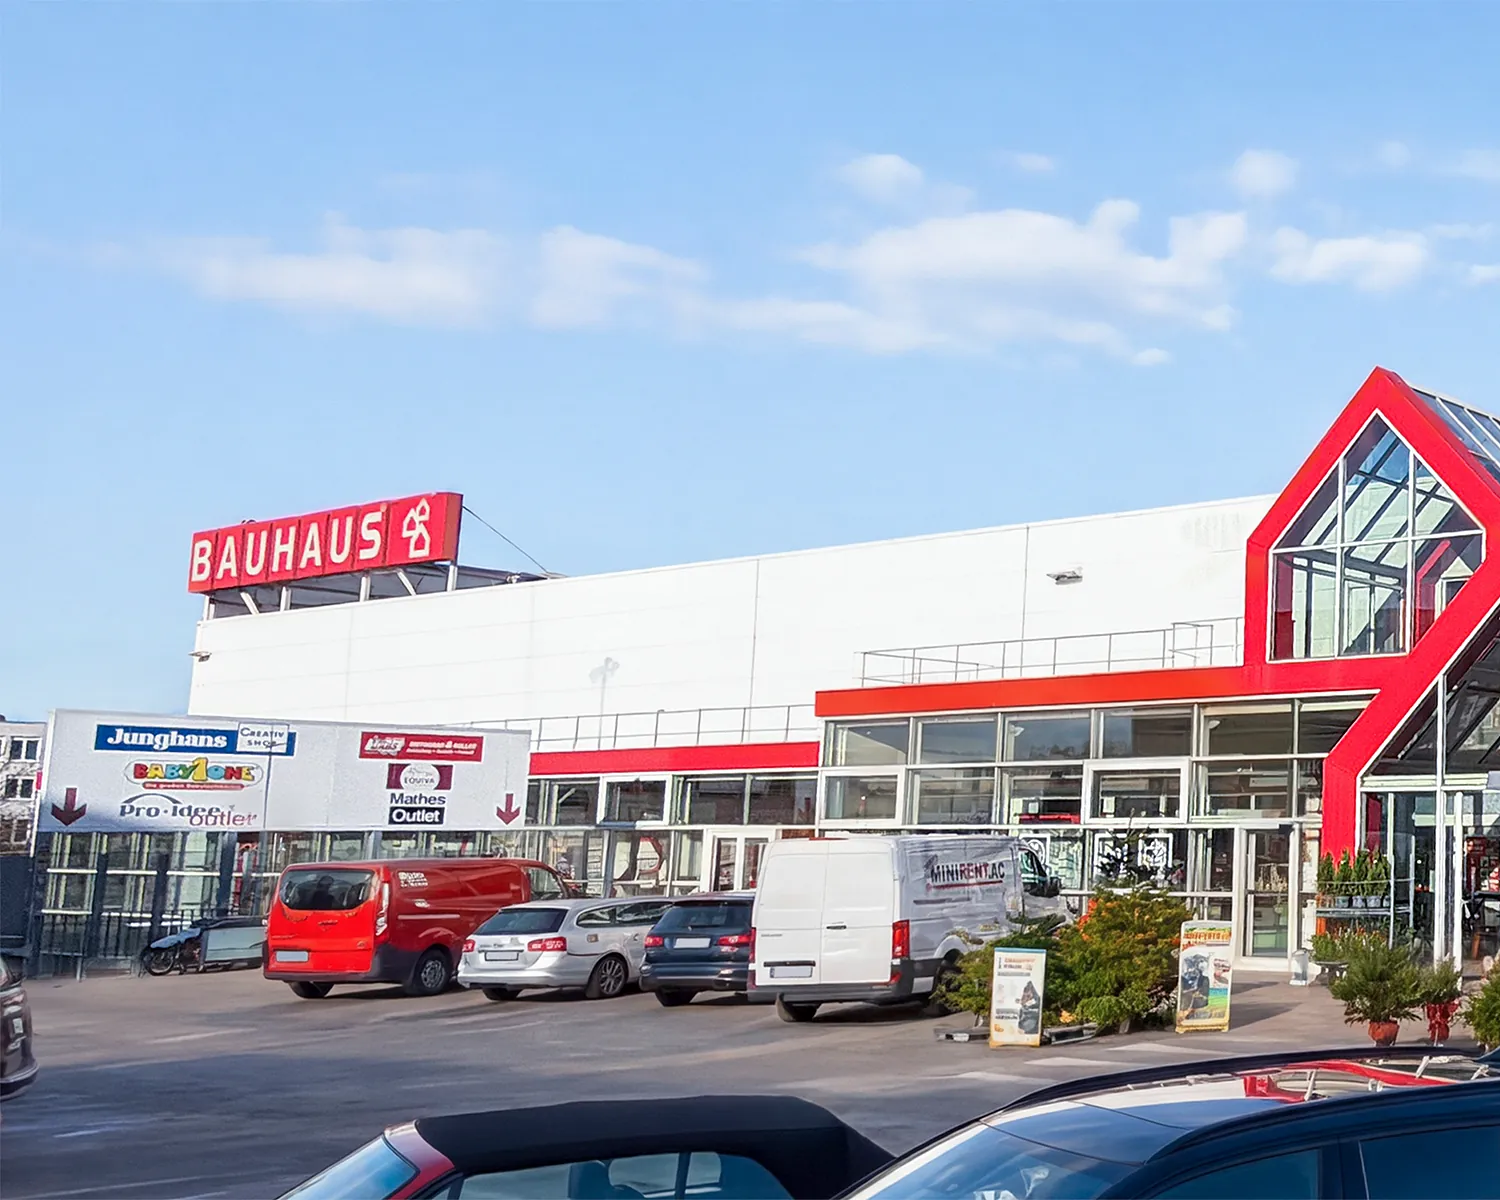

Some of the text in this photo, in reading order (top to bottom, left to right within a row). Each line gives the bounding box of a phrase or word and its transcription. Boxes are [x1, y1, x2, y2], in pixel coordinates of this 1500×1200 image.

[191, 511, 382, 582] BAUHAUS
[107, 728, 228, 750] Junghans
[390, 793, 446, 805] Mathes
[392, 808, 441, 823] Outlet
[931, 861, 1005, 882] MINIRENT.AC
